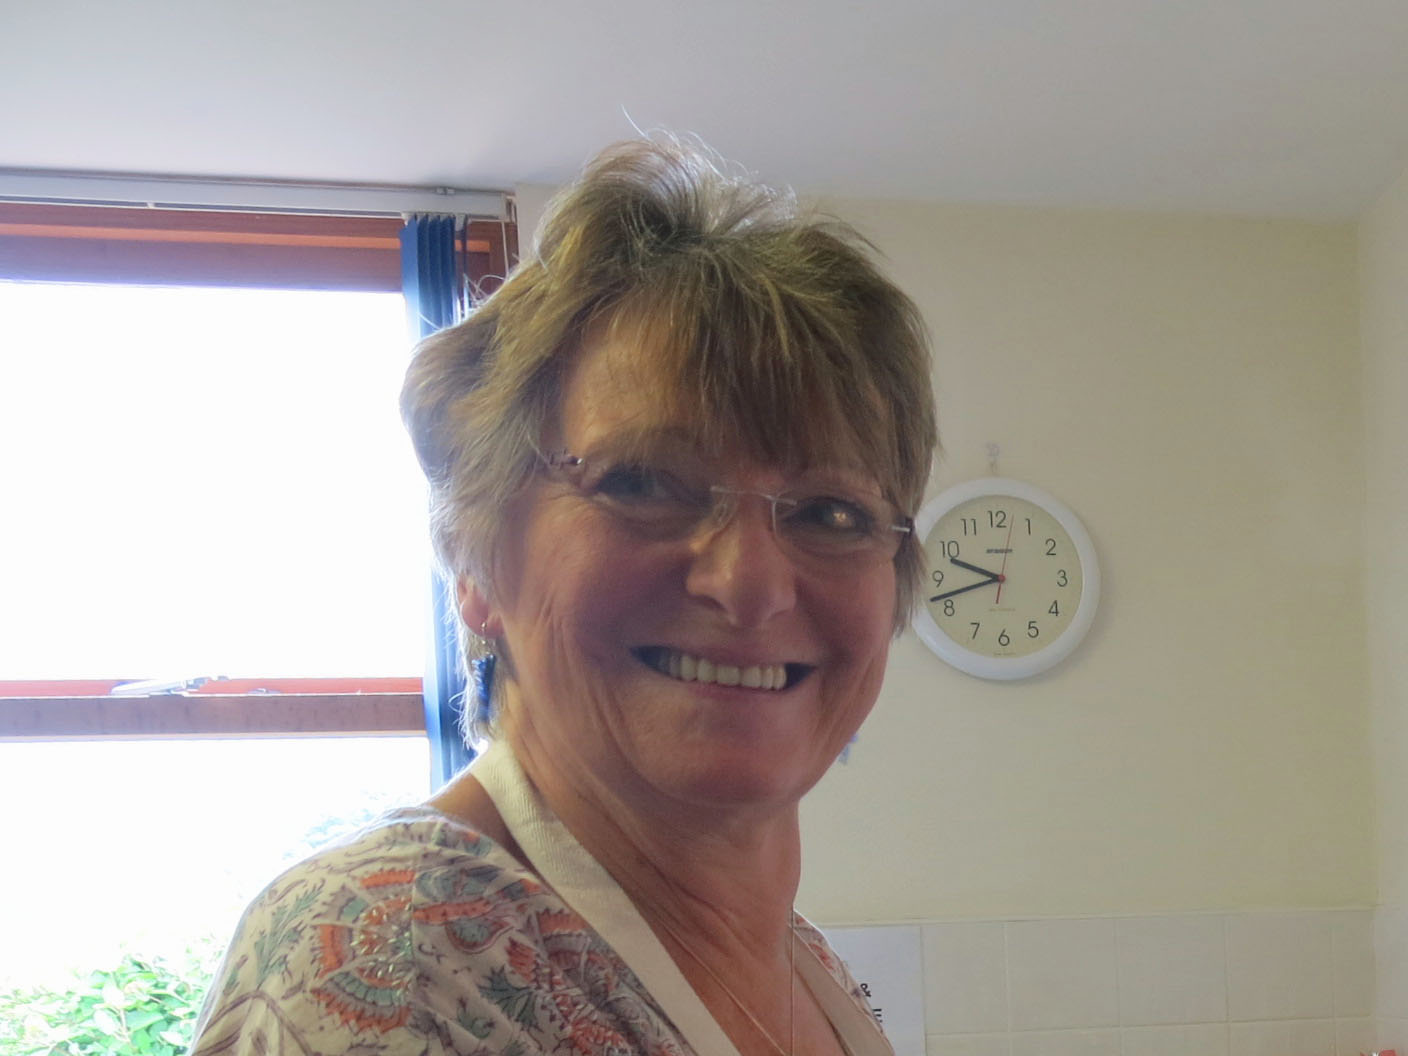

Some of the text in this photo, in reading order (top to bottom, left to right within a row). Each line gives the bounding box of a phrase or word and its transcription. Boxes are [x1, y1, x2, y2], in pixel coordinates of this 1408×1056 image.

[960, 518, 977, 536] 11
[987, 510, 1007, 528] 12
[1025, 518, 1032, 536] 1
[940, 540, 960, 558] 10
[1045, 538, 1057, 556] 2
[932, 570, 944, 588] 9
[1056, 569, 1068, 587] 3
[943, 599, 956, 617] 8
[1048, 599, 1060, 617] 4
[970, 622, 981, 640] 7
[998, 628, 1010, 647] 6
[1027, 621, 1039, 639] 5
